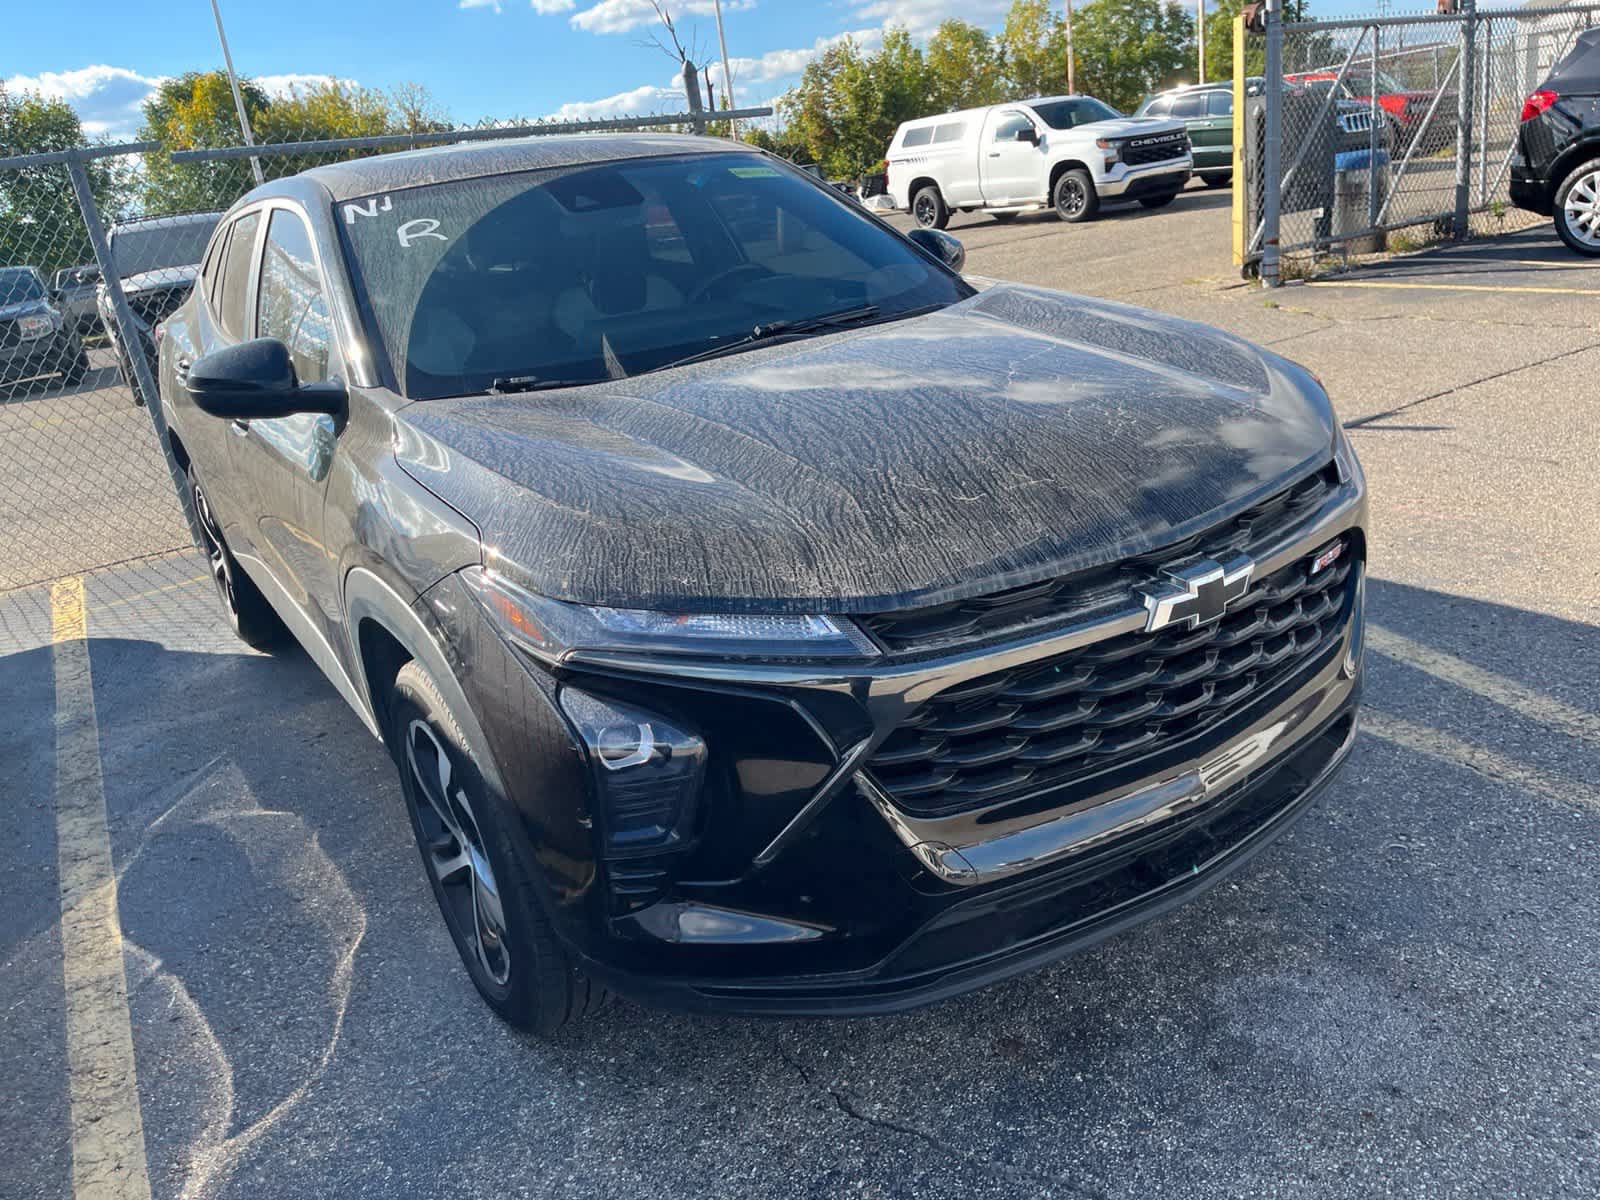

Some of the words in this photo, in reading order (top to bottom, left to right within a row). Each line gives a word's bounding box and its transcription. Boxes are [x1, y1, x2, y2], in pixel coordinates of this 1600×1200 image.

[1130, 132, 1186, 147] CHEVROLET
[396, 218, 449, 248] R
[1311, 543, 1343, 574] RS
